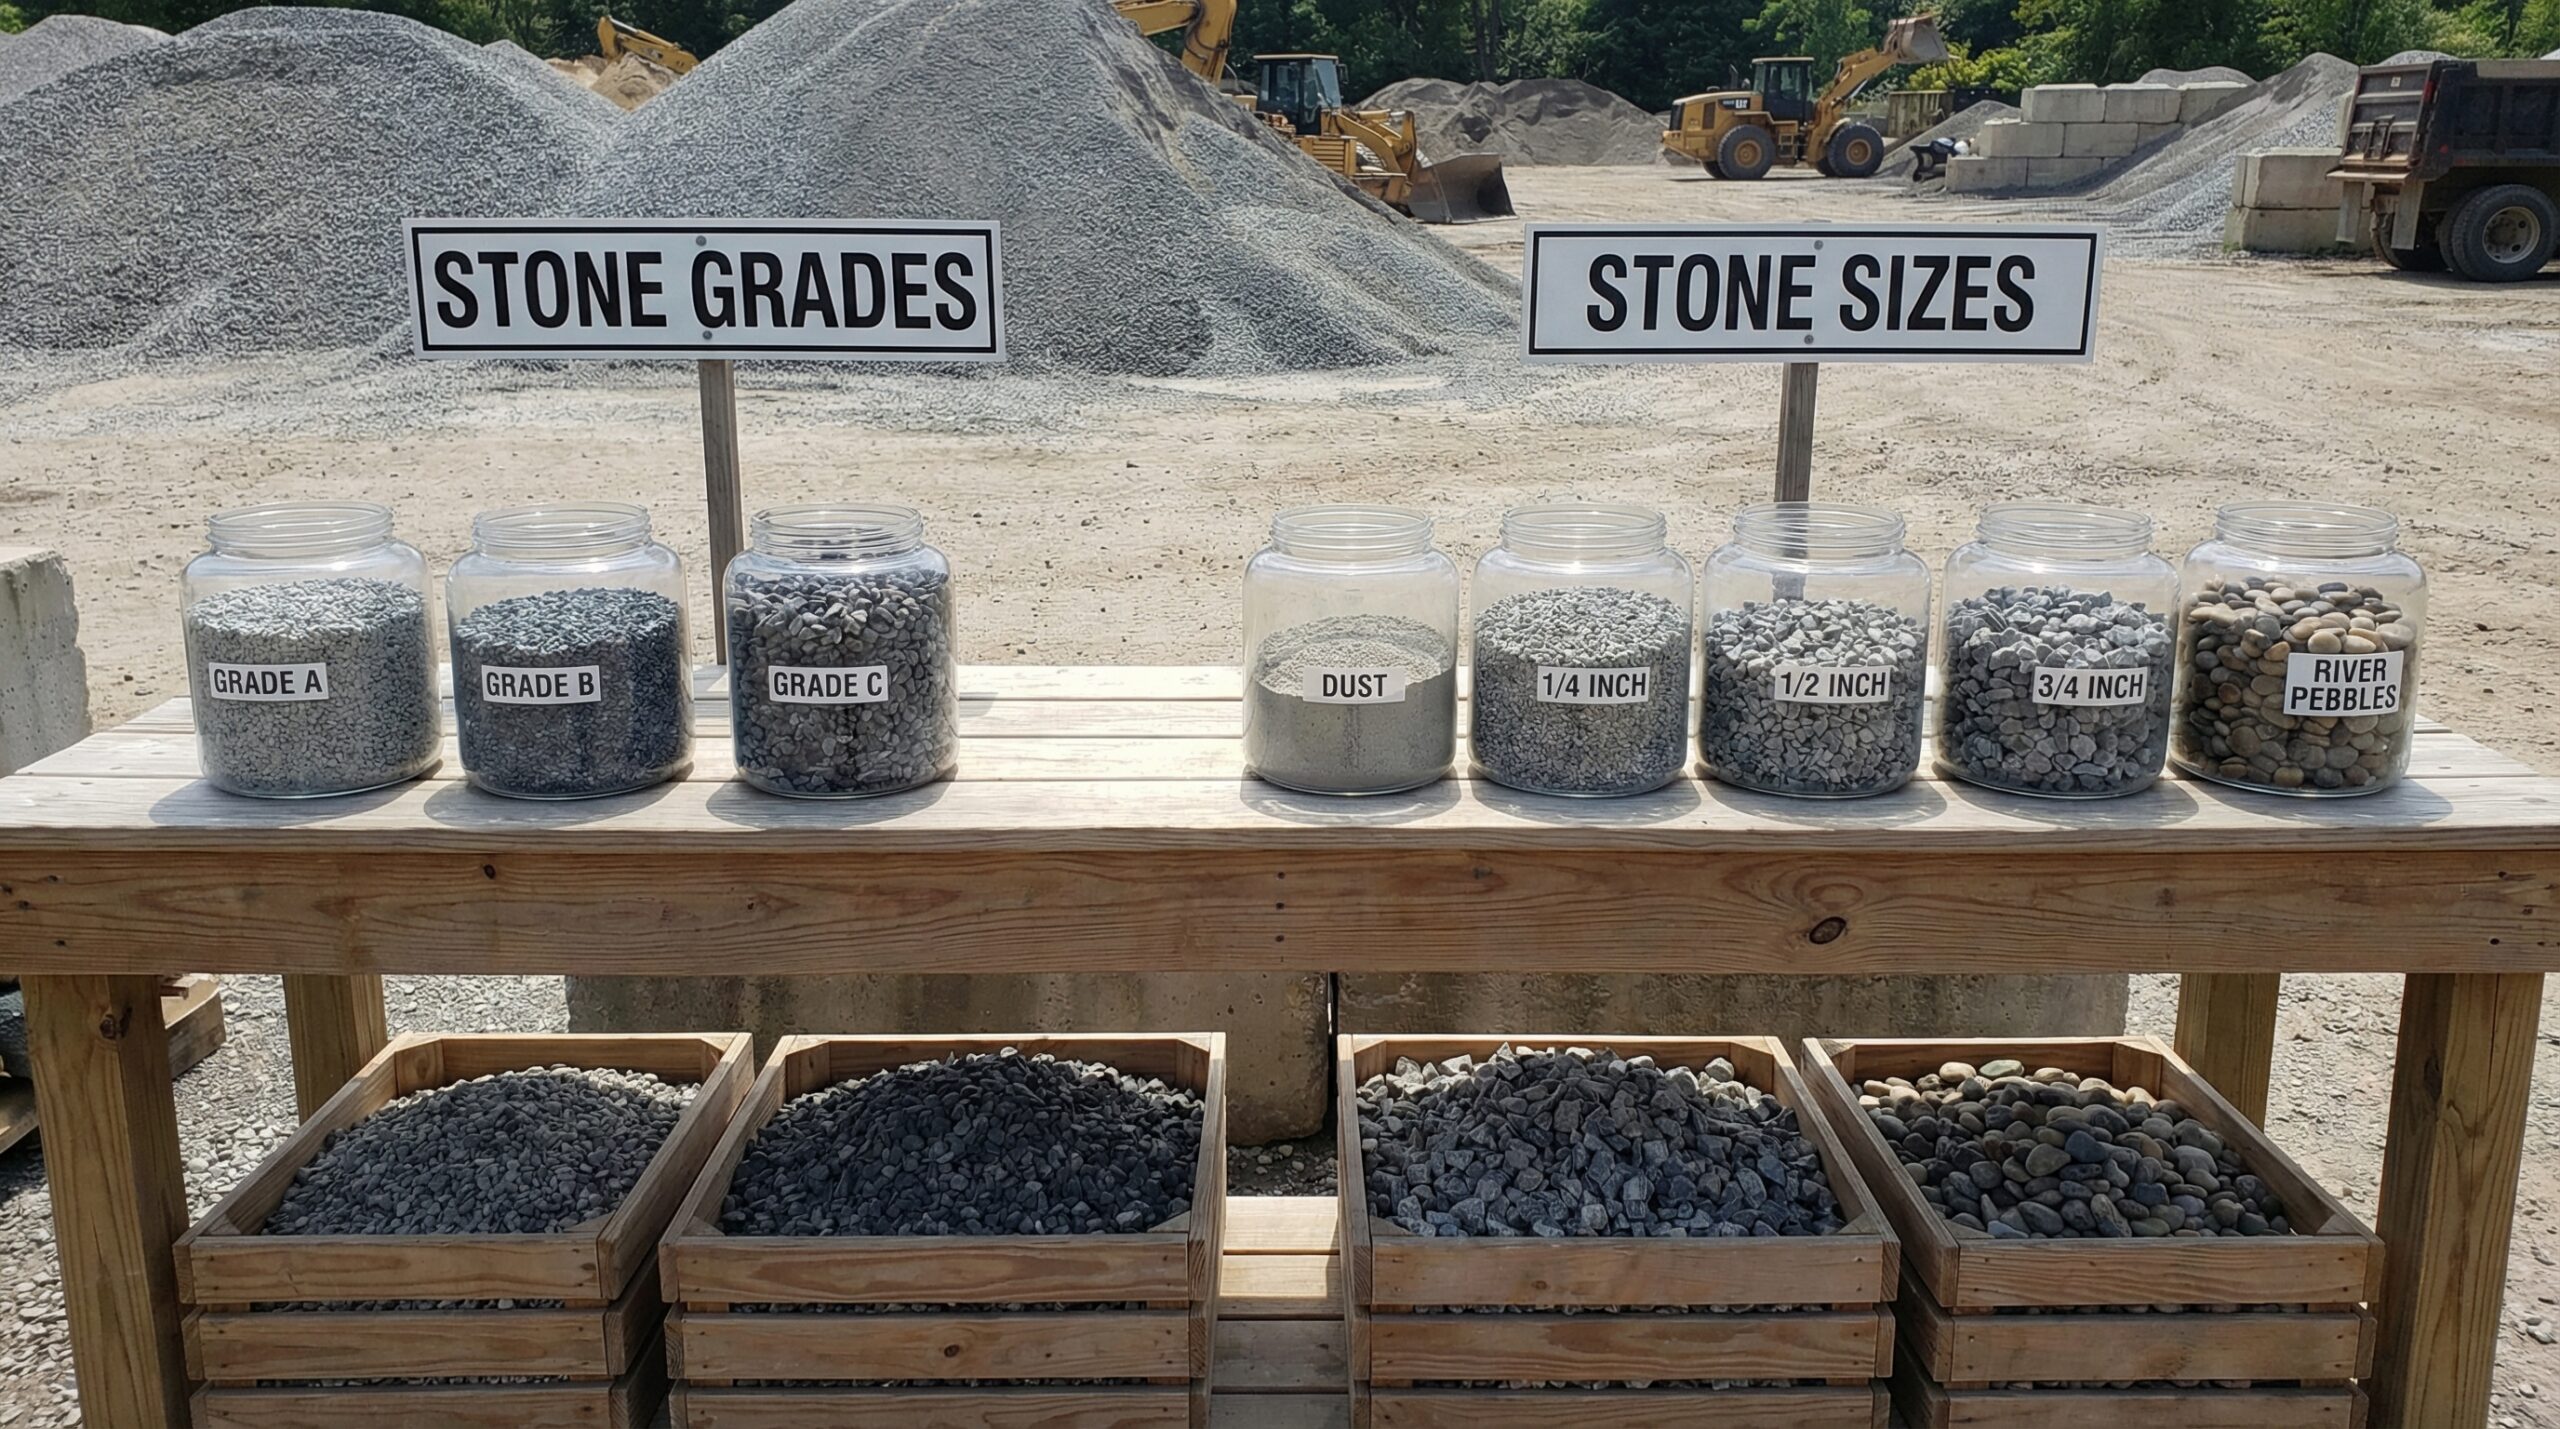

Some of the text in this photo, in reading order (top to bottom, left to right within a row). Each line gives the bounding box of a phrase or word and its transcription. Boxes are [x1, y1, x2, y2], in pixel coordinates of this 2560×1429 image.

[433, 249, 977, 330] STONE GRADES
[1586, 253, 2036, 333] STONE SIZES
[213, 668, 323, 695] GRADE A
[2313, 658, 2387, 683] RIVER
[486, 671, 595, 698] GRADE B
[773, 671, 883, 698] GRADE C
[1322, 673, 1388, 698] DUST
[1542, 672, 1647, 699] 1/4 INCH
[1780, 671, 1887, 698] 1/2 INCH
[2037, 673, 2144, 701] 3/4 INCH
[2290, 684, 2397, 712] PEBBLES
